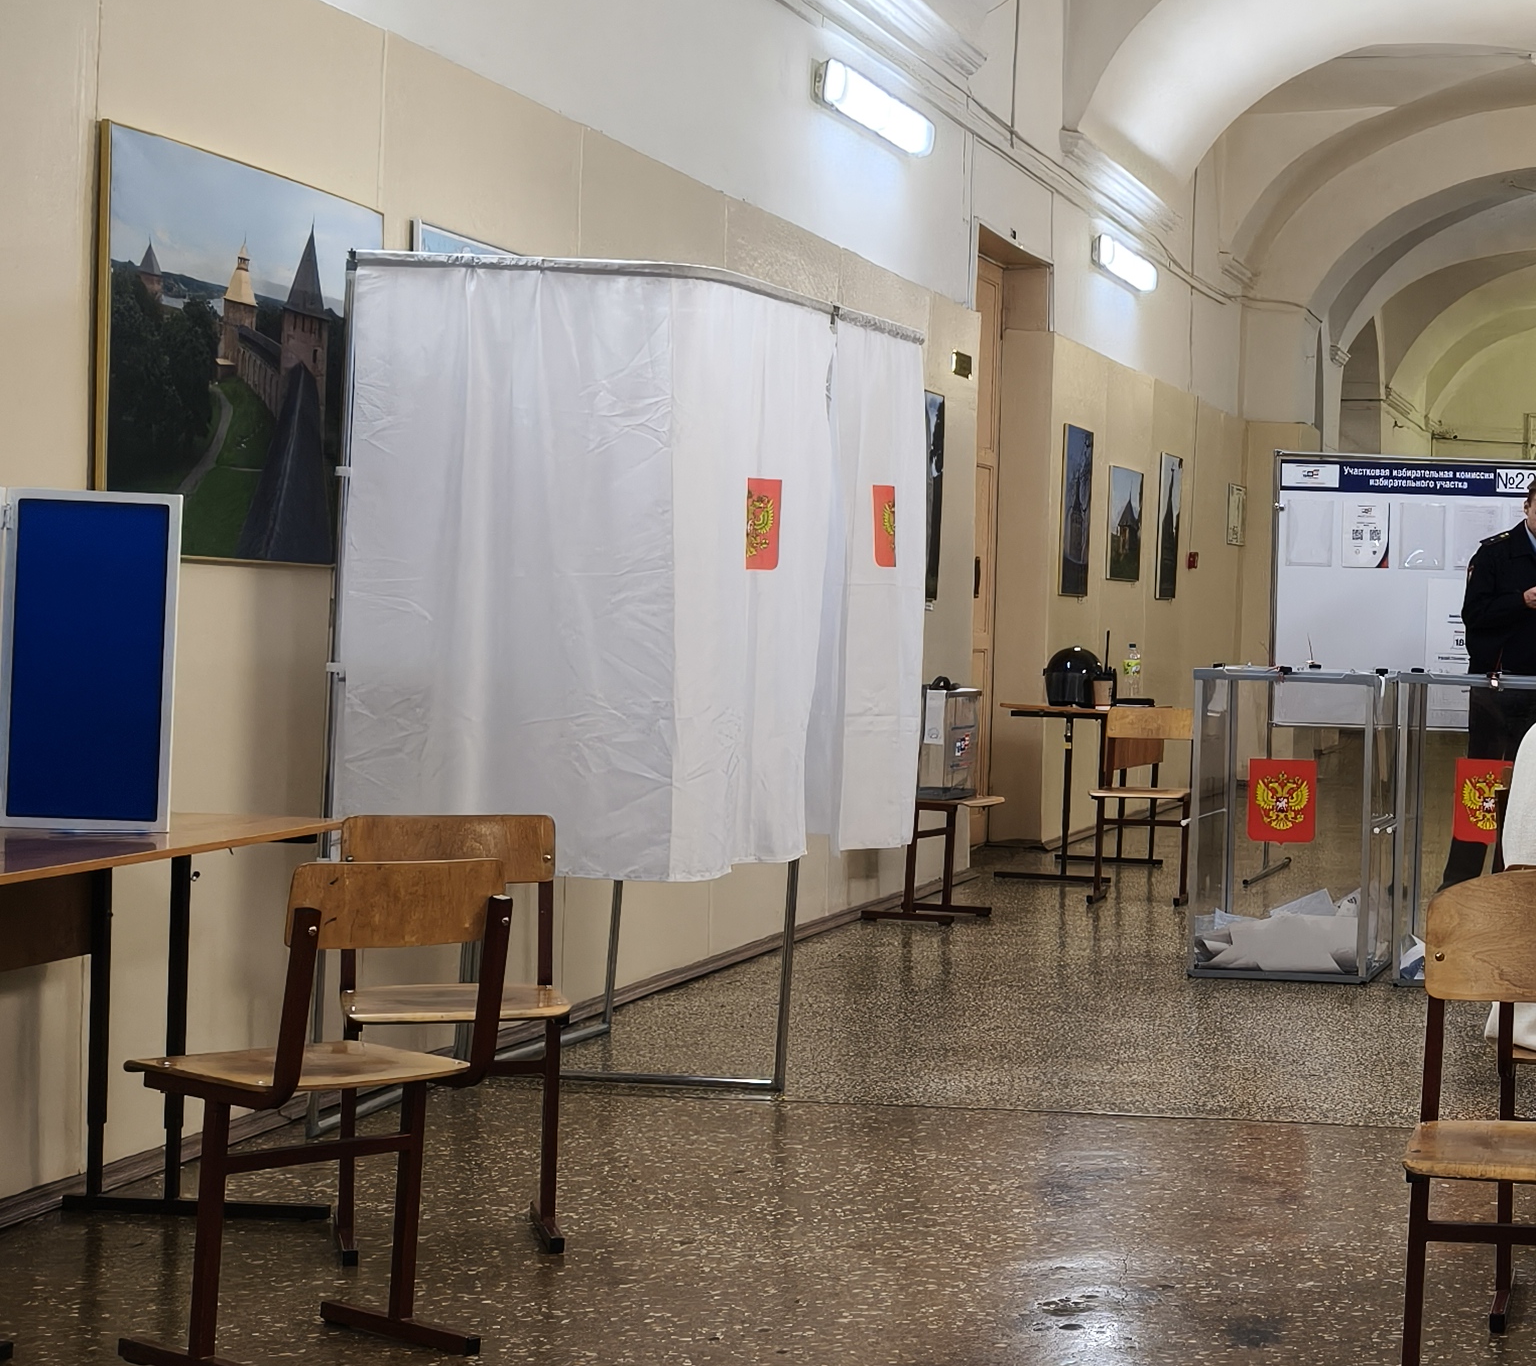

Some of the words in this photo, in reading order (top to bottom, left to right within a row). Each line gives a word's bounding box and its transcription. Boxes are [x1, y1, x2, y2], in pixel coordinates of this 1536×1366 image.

[1343, 466, 1390, 476] Участковая
[1392, 468, 1454, 479] избирательная
[1456, 471, 1494, 480] комиссия
[1369, 477, 1435, 488] избирательного
[1436, 480, 1468, 490] участка
